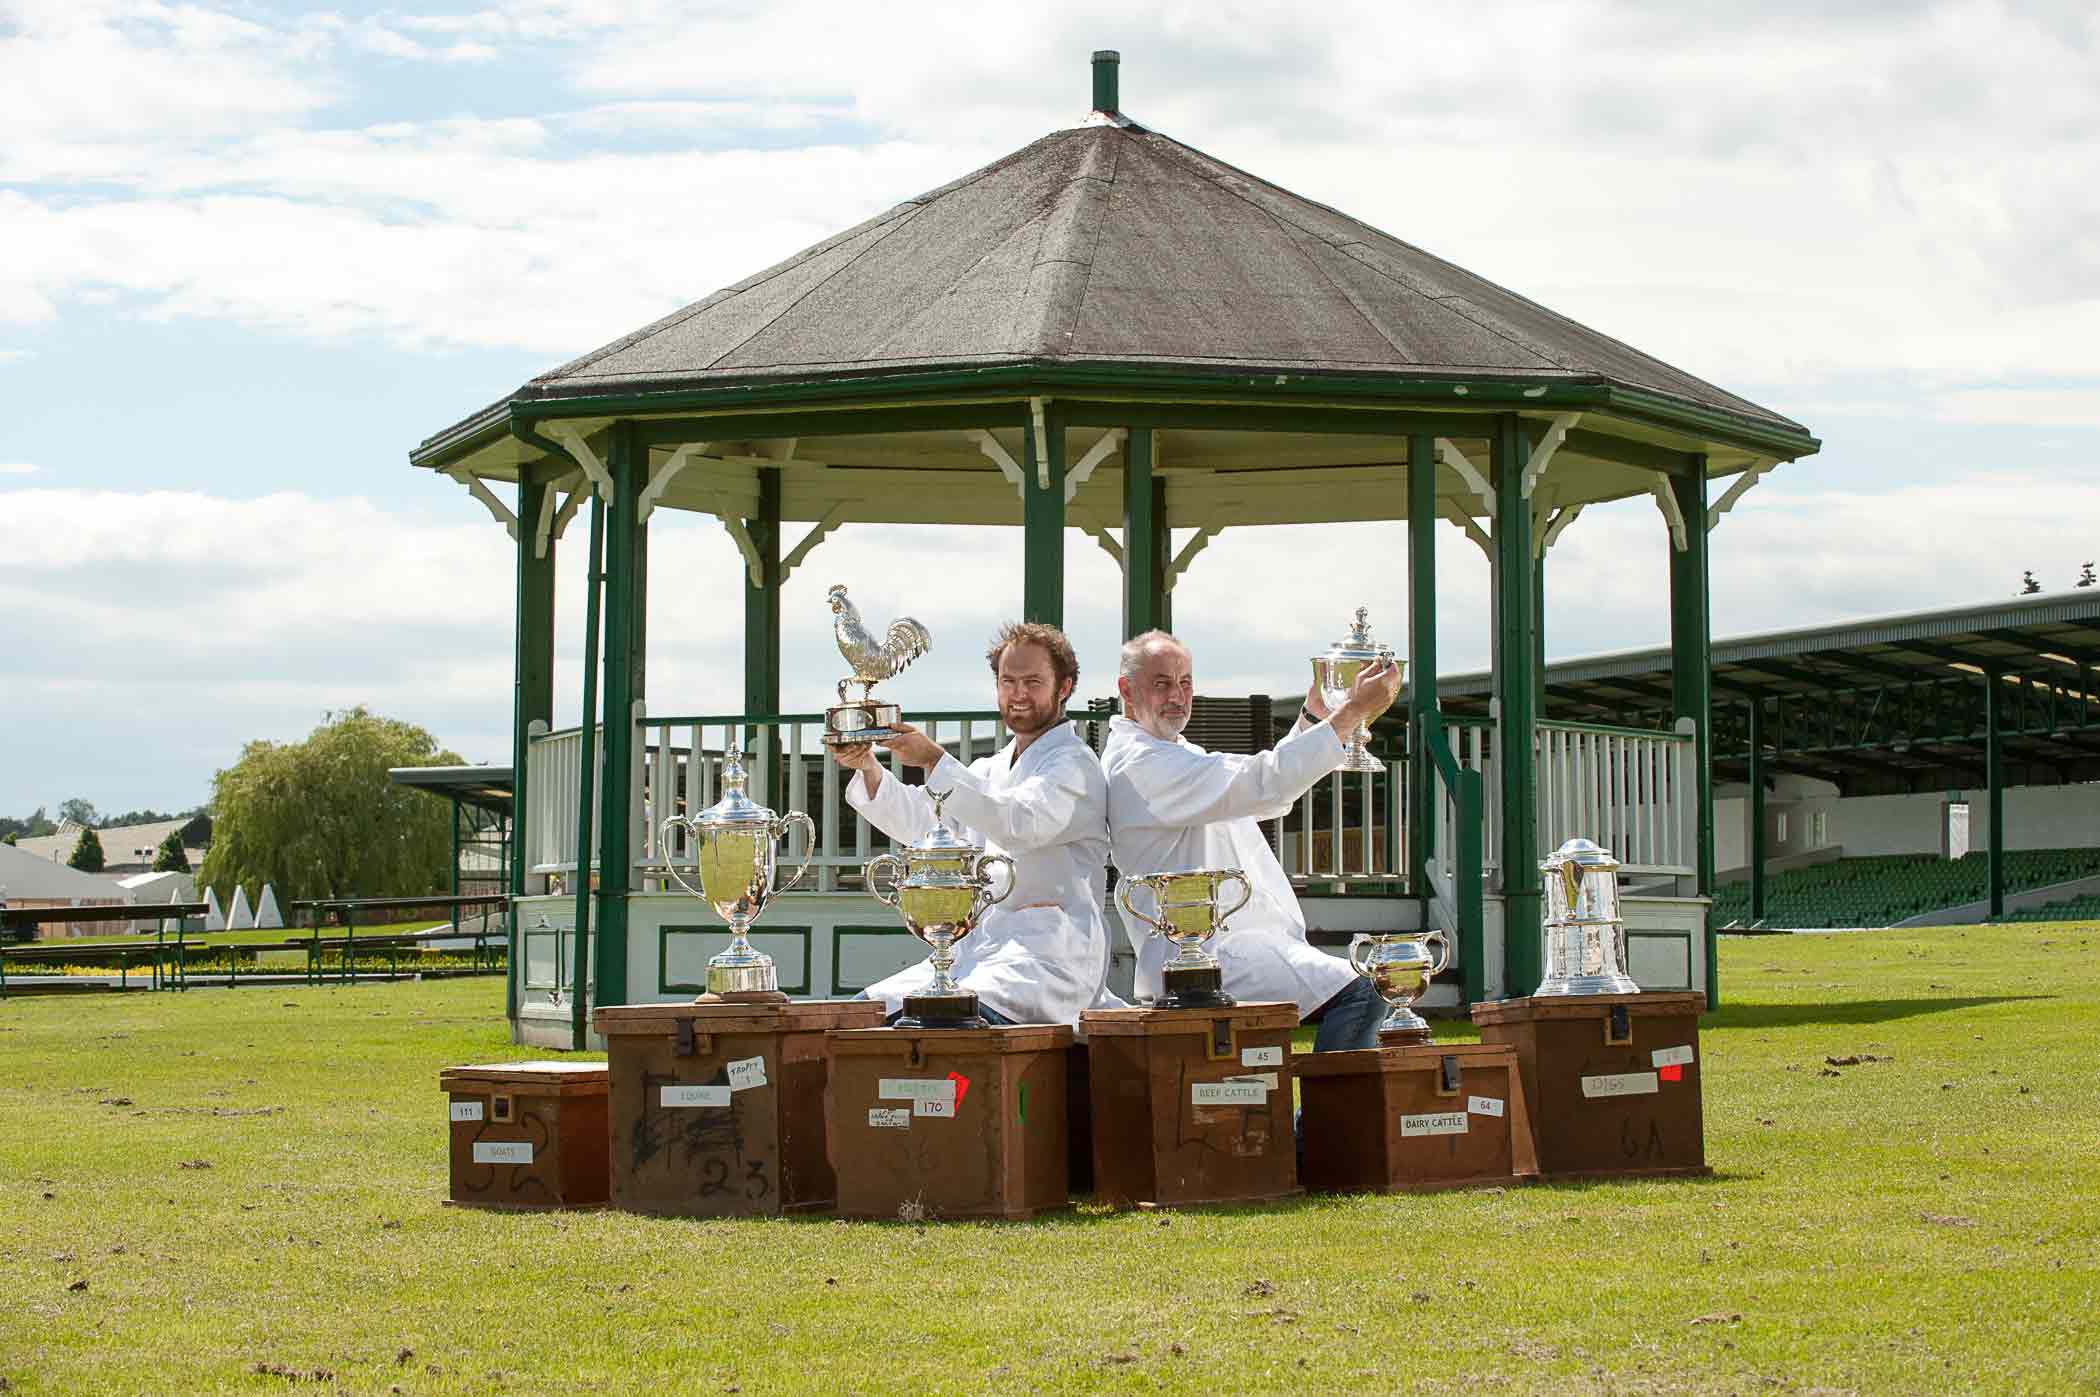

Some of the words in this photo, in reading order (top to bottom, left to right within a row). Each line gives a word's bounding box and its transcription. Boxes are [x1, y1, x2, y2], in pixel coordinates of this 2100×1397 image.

[1199, 1087, 1221, 1097] BEEF
[1224, 1086, 1259, 1097] CATTLE
[924, 1102, 943, 1113] 170
[1405, 1118, 1430, 1129] DAIRY
[1432, 1116, 1464, 1128] CATTLE
